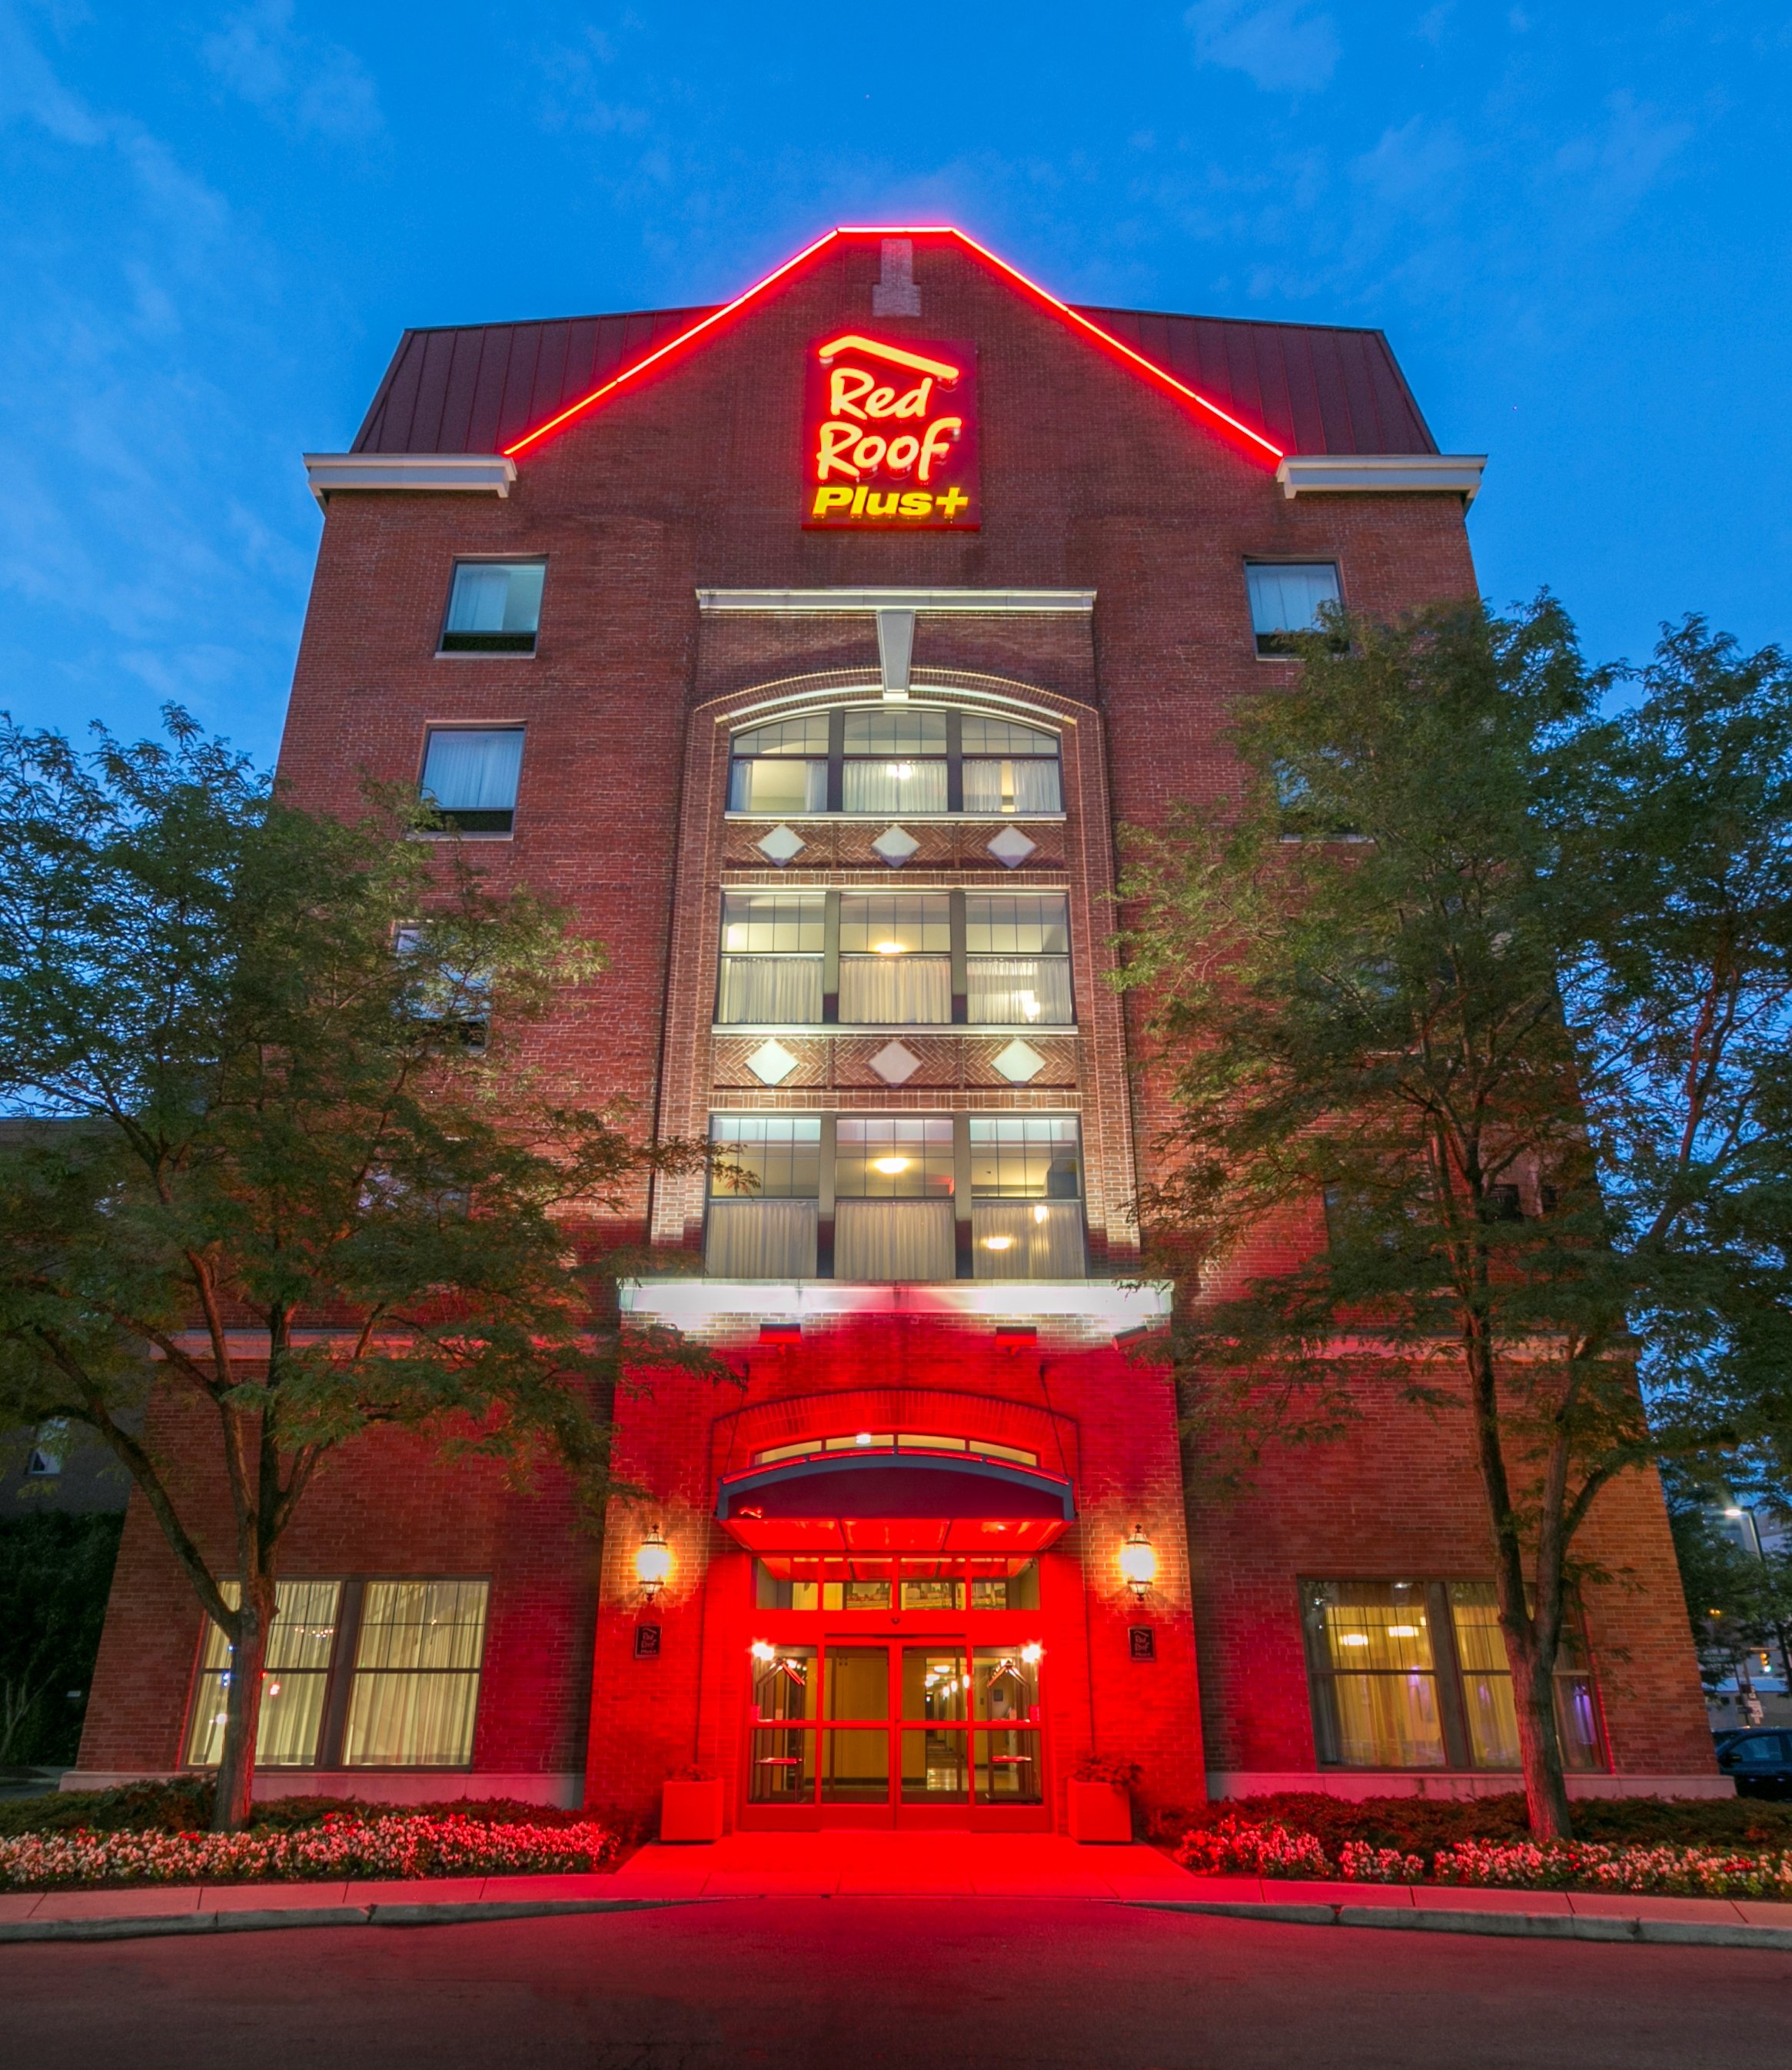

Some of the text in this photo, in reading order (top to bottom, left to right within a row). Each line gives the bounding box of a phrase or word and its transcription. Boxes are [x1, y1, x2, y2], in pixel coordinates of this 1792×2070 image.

[830, 367, 933, 420] Red
[816, 417, 962, 480] Roof
[812, 487, 968, 516] Plus+
